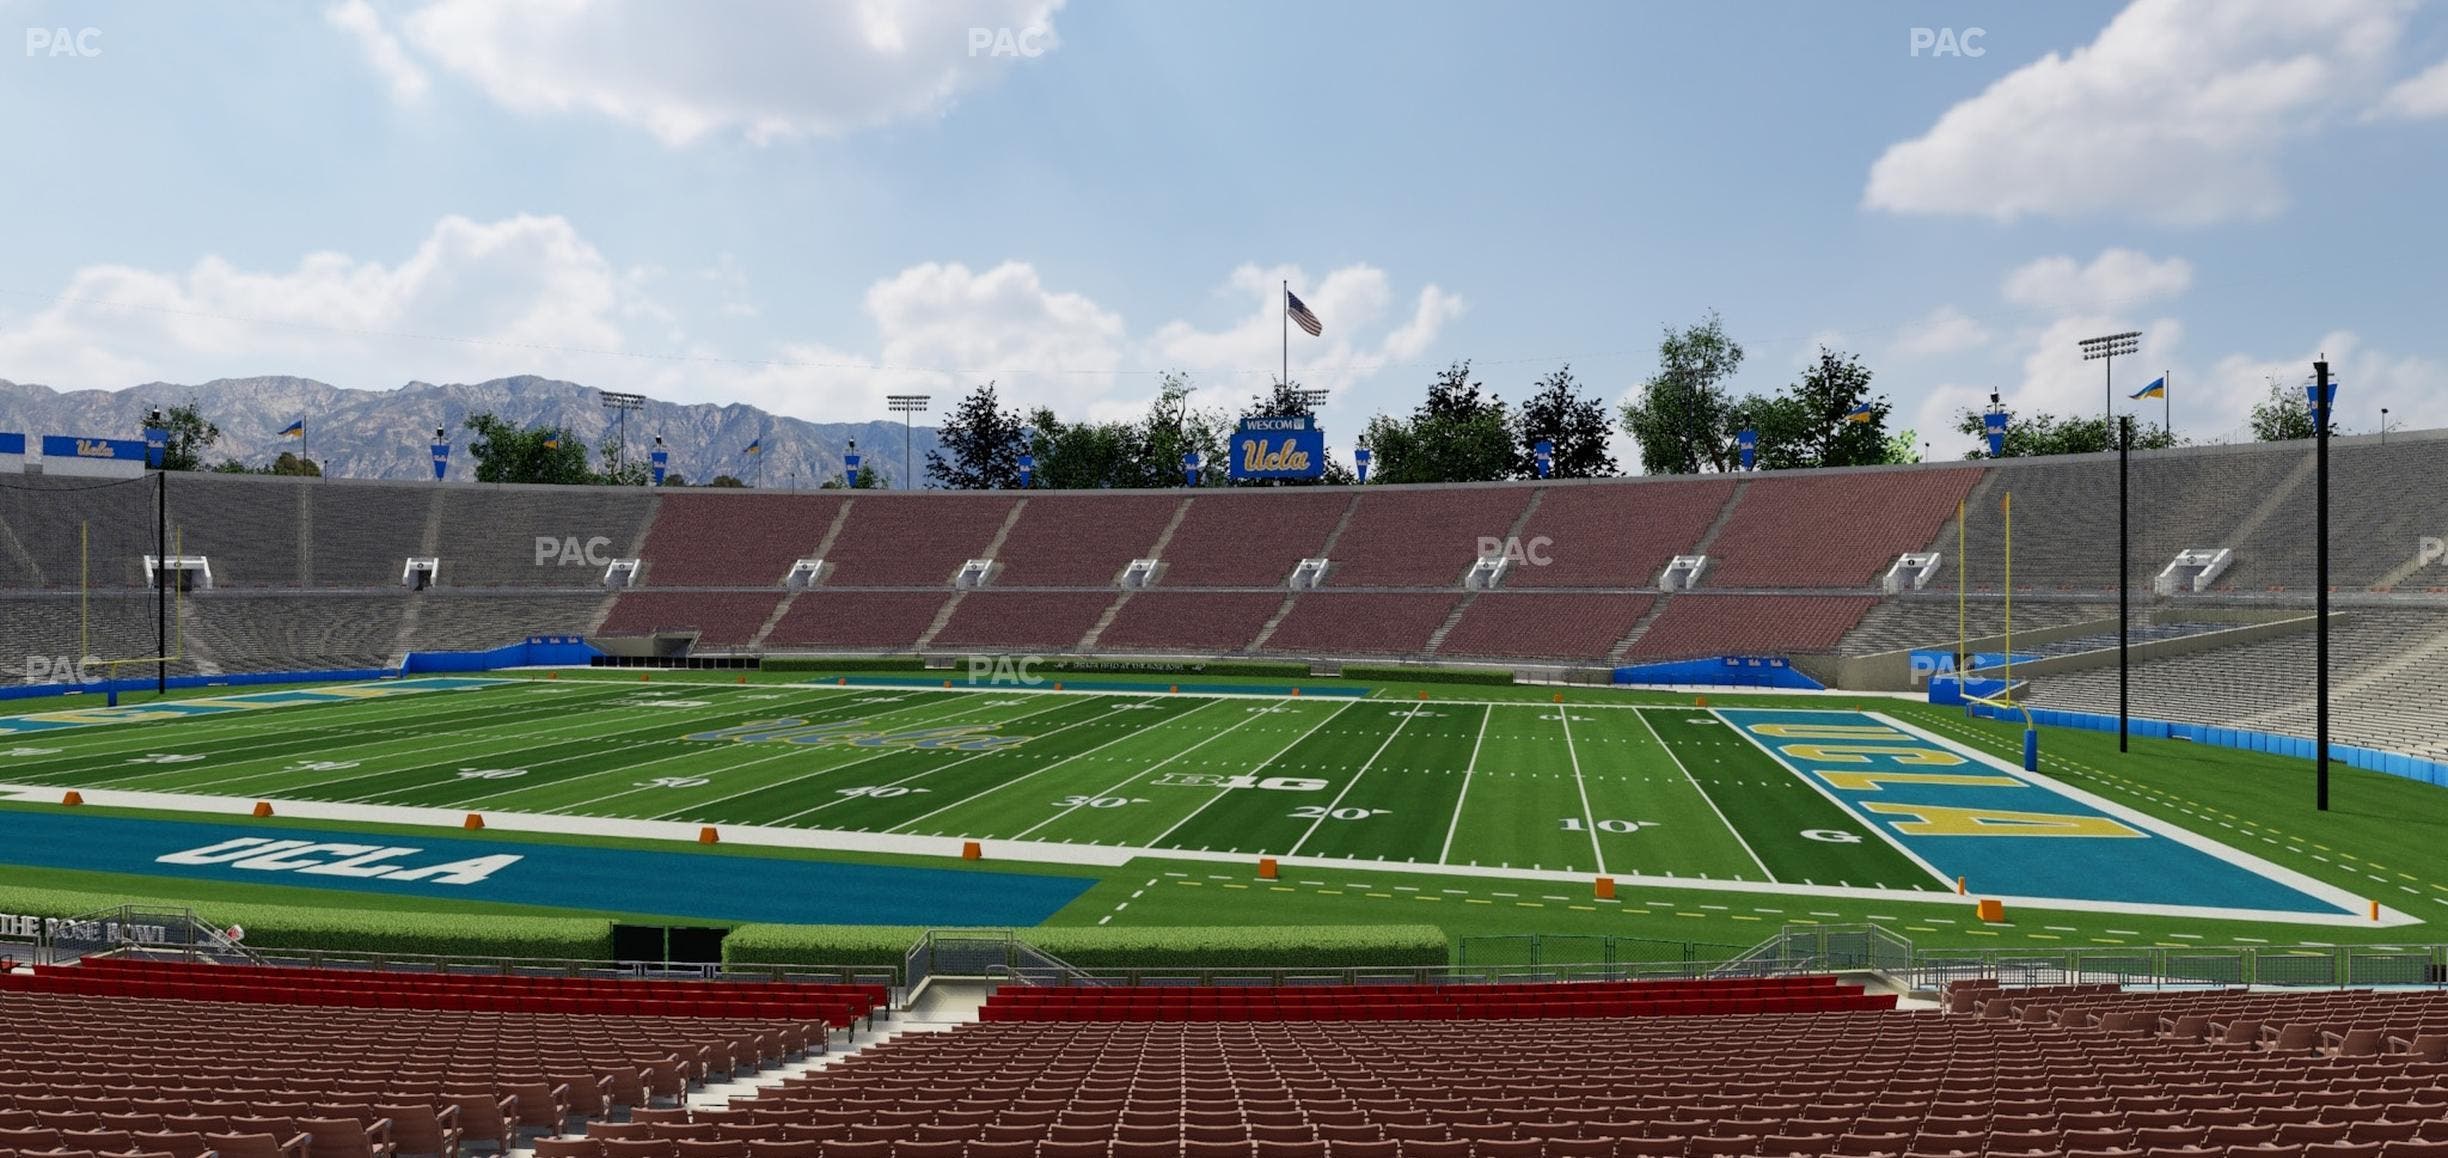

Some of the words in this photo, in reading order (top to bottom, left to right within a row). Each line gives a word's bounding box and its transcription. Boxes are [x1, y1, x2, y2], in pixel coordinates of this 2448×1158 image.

[1246, 420, 1293, 430] WESCOM
[1242, 438, 1311, 471] Ucla
[1747, 722, 2152, 839] UCLA
[835, 785, 910, 798] 40
[1050, 795, 1128, 808] 30
[1286, 805, 1371, 820] 20
[1558, 817, 1640, 833] 10
[1799, 828, 1863, 843] G
[155, 837, 524, 885] UCLA
